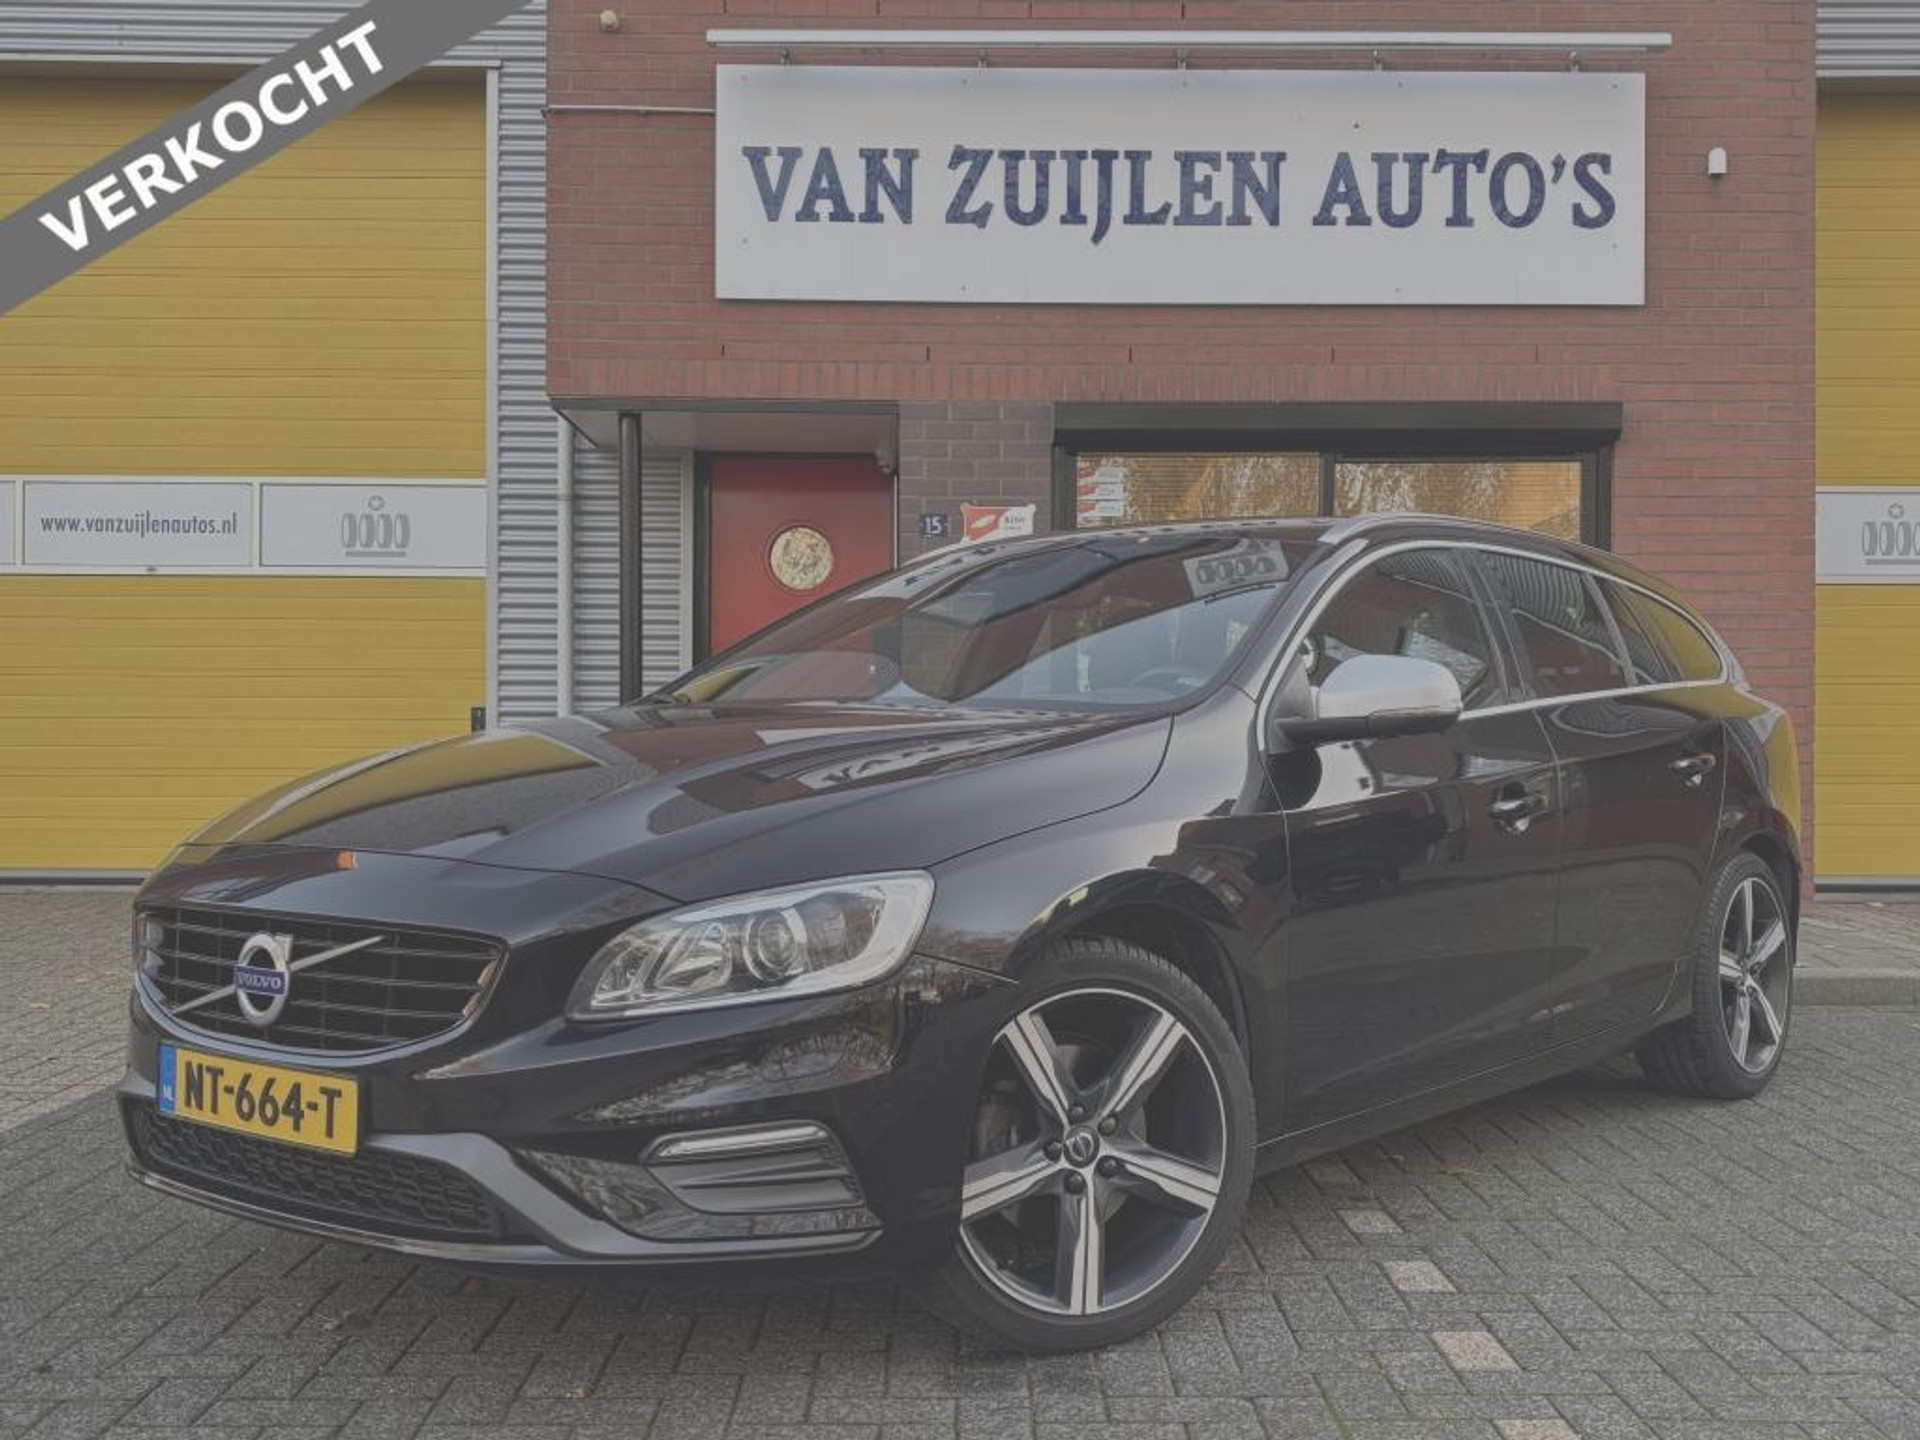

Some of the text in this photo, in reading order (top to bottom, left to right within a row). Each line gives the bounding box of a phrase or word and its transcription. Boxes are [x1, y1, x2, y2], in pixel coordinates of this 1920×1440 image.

[742, 144, 1616, 243] VAN ZUIJLEN AUTO'S
[43, 510, 238, 538] www.vanzuijlenautos.nl
[925, 517, 943, 534] 15
[236, 972, 282, 990] VOLVO
[184, 1061, 342, 1139] NT-664-T
